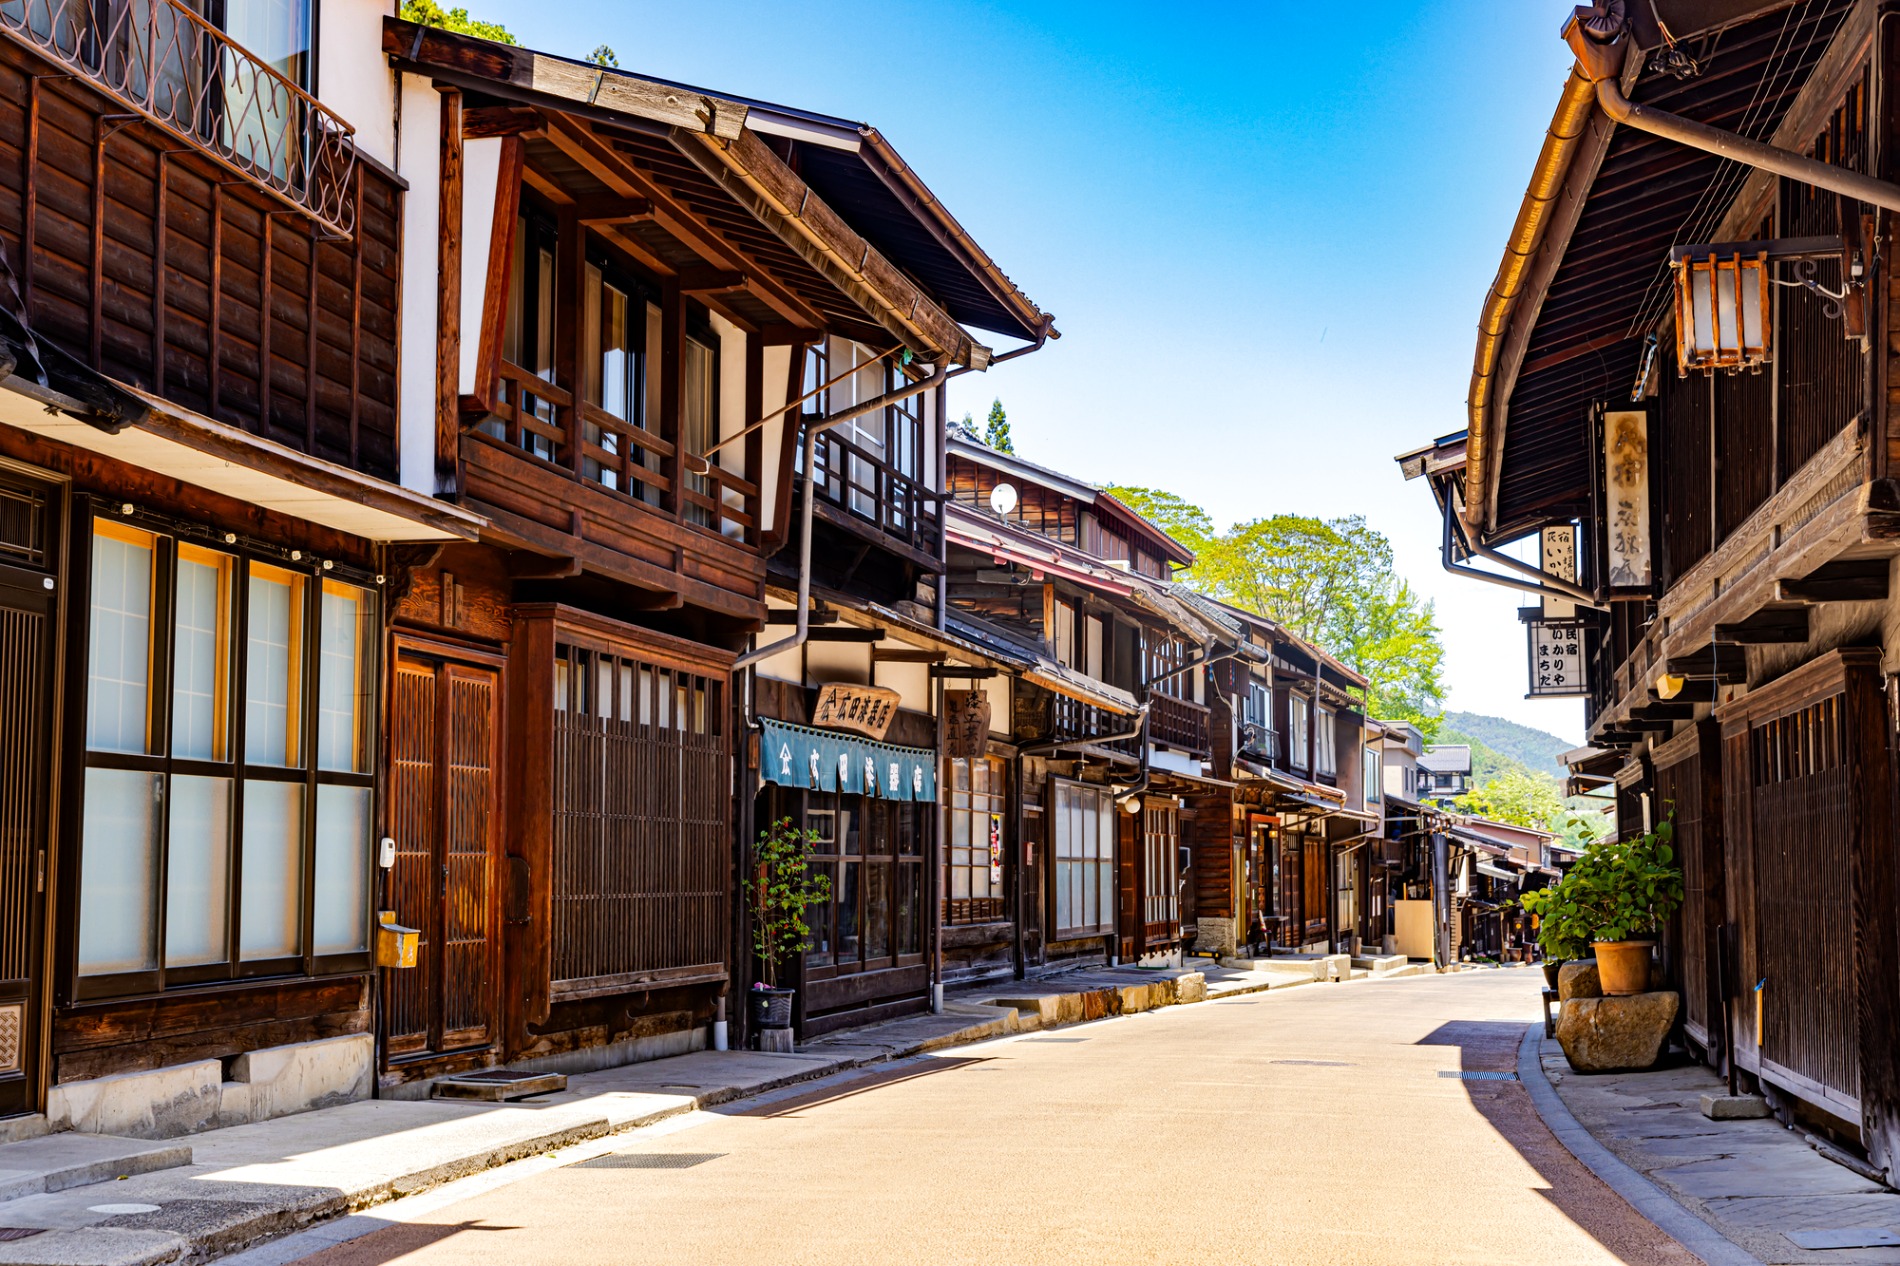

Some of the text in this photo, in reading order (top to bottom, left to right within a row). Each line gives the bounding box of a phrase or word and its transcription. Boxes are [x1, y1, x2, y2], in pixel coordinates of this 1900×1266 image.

[1547, 531, 1570, 543] 民宿
[1552, 629, 1565, 686] いかりや
[1565, 629, 1578, 656] 民宿
[1539, 644, 1551, 686] まちだ
